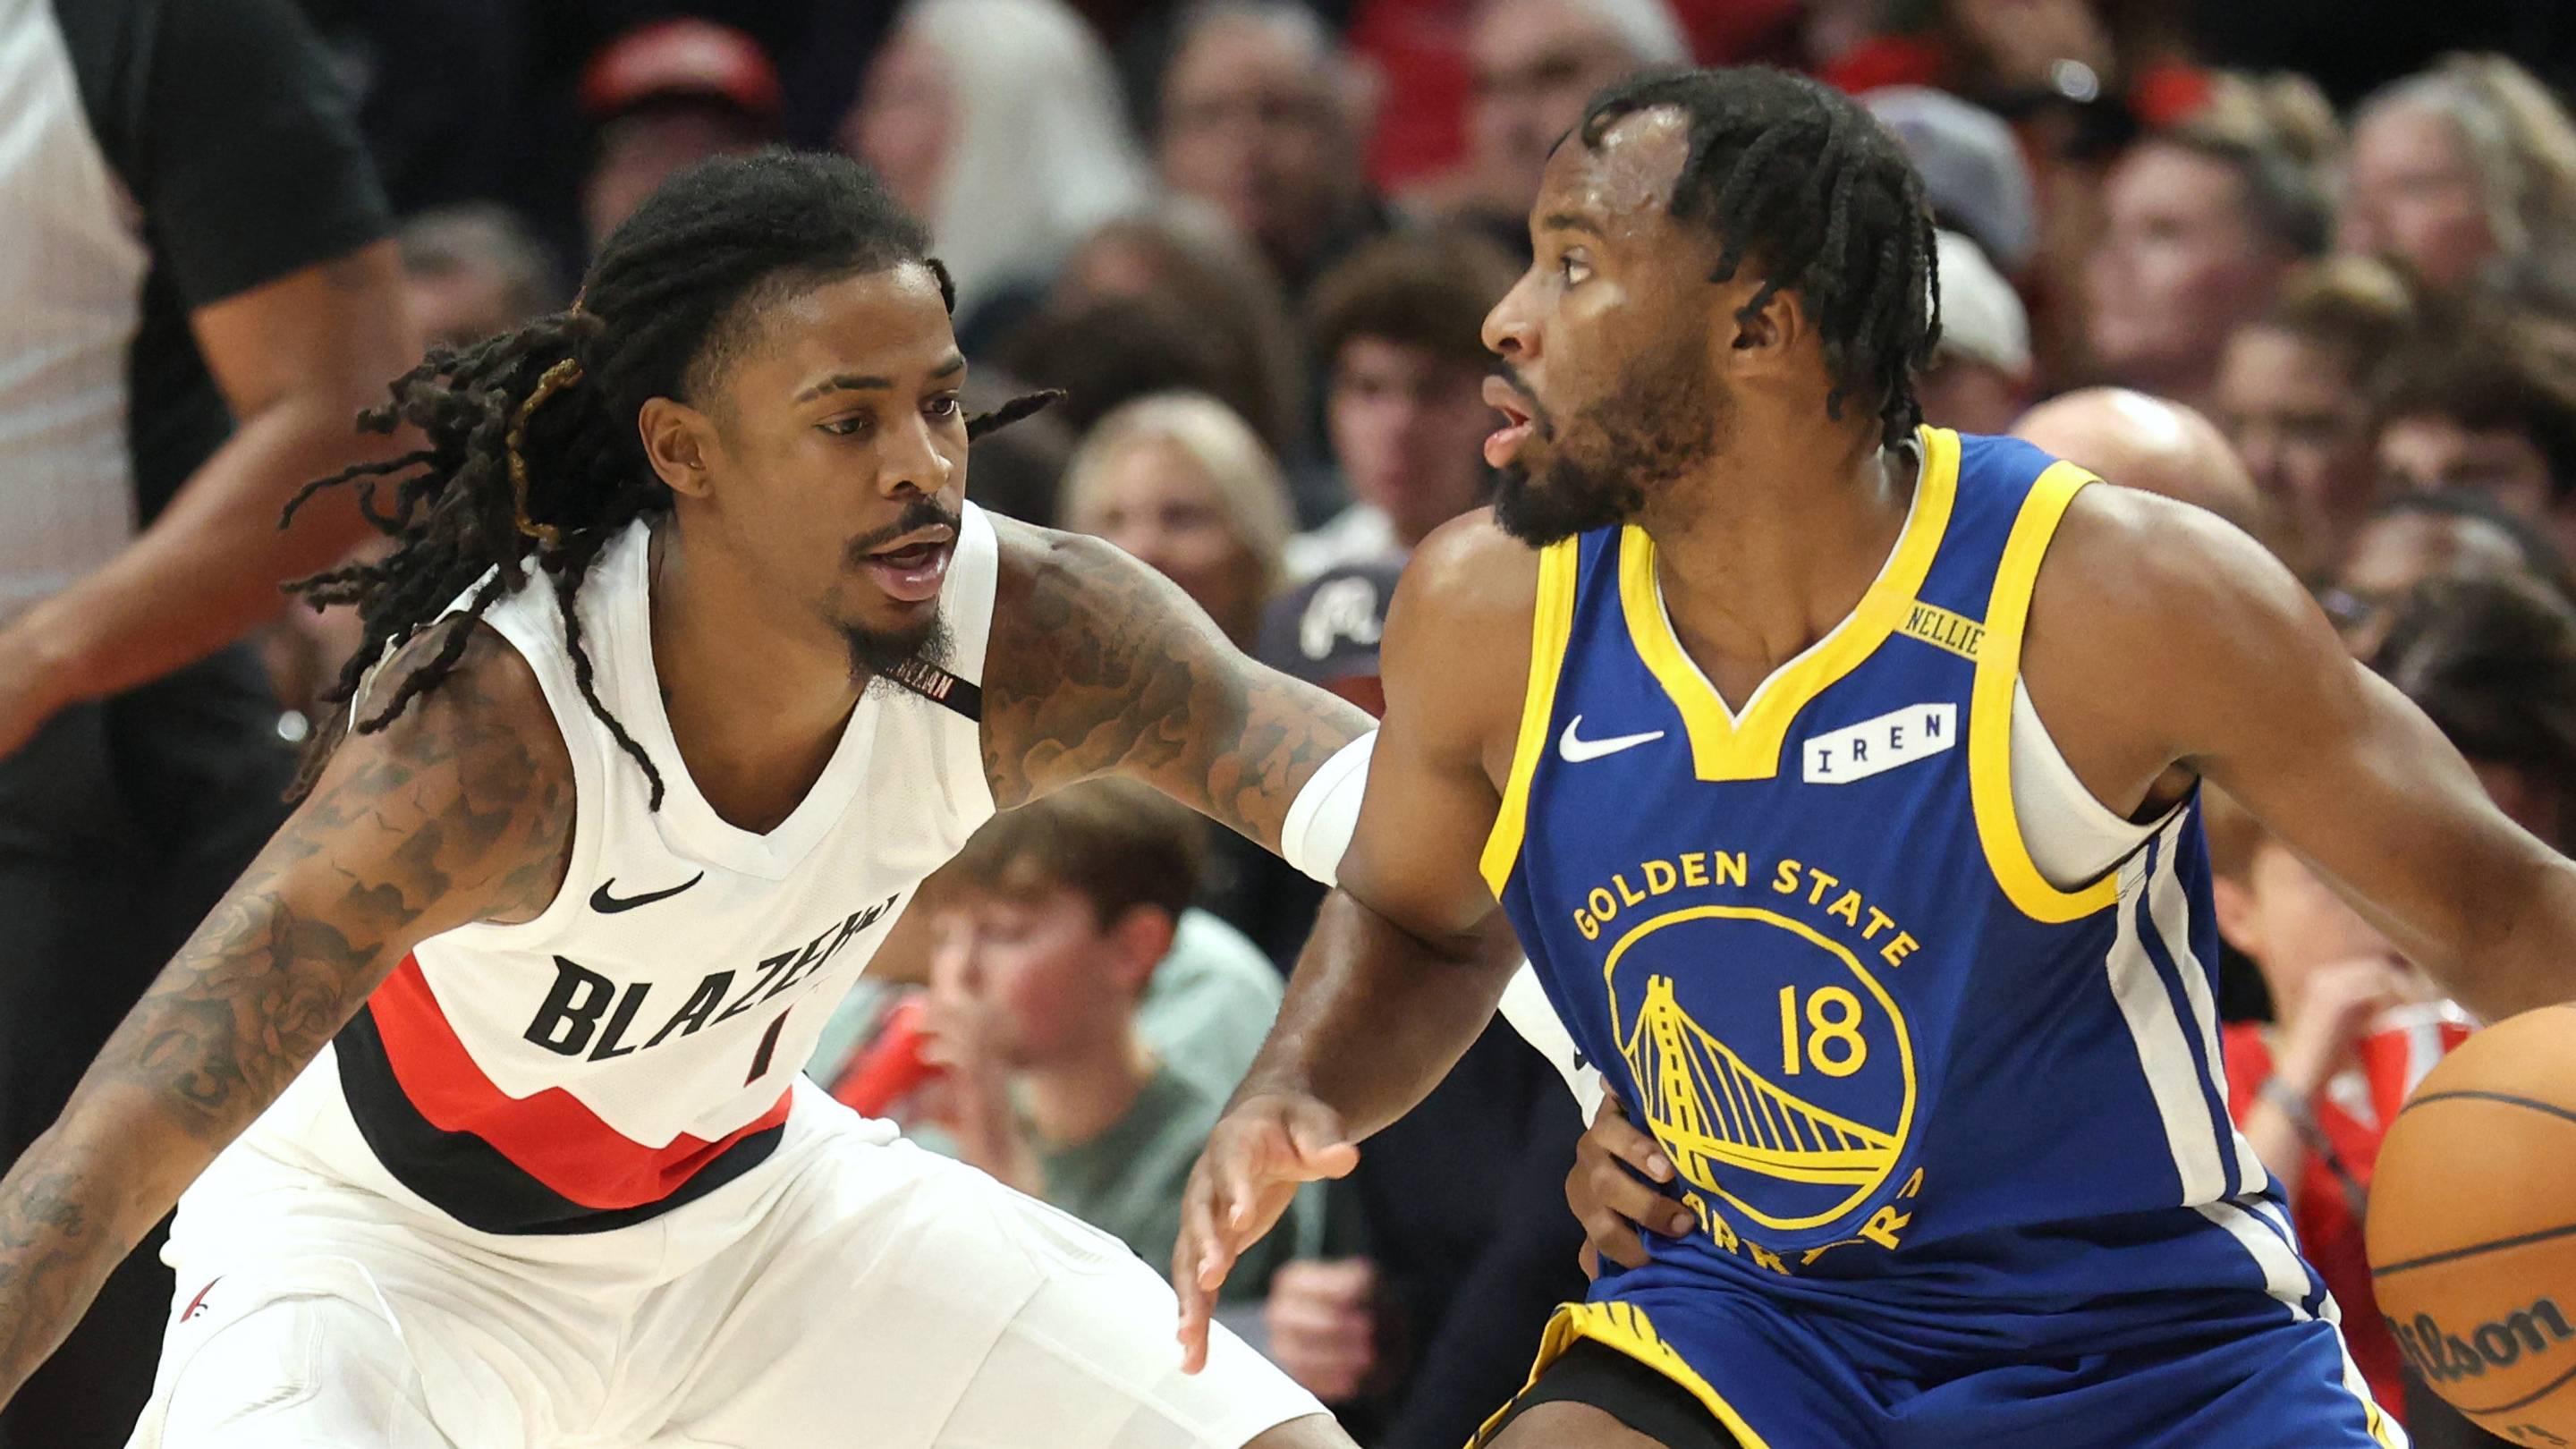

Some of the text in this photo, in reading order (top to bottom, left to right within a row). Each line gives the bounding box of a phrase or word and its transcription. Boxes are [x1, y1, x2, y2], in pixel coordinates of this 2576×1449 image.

[1906, 606, 1986, 655] NELLIE
[1818, 714, 1941, 774] IREN
[1573, 851, 1920, 968] GOLDEN STATE
[1778, 984, 1868, 1078] 18
[2386, 1298, 2576, 1381] ilson
